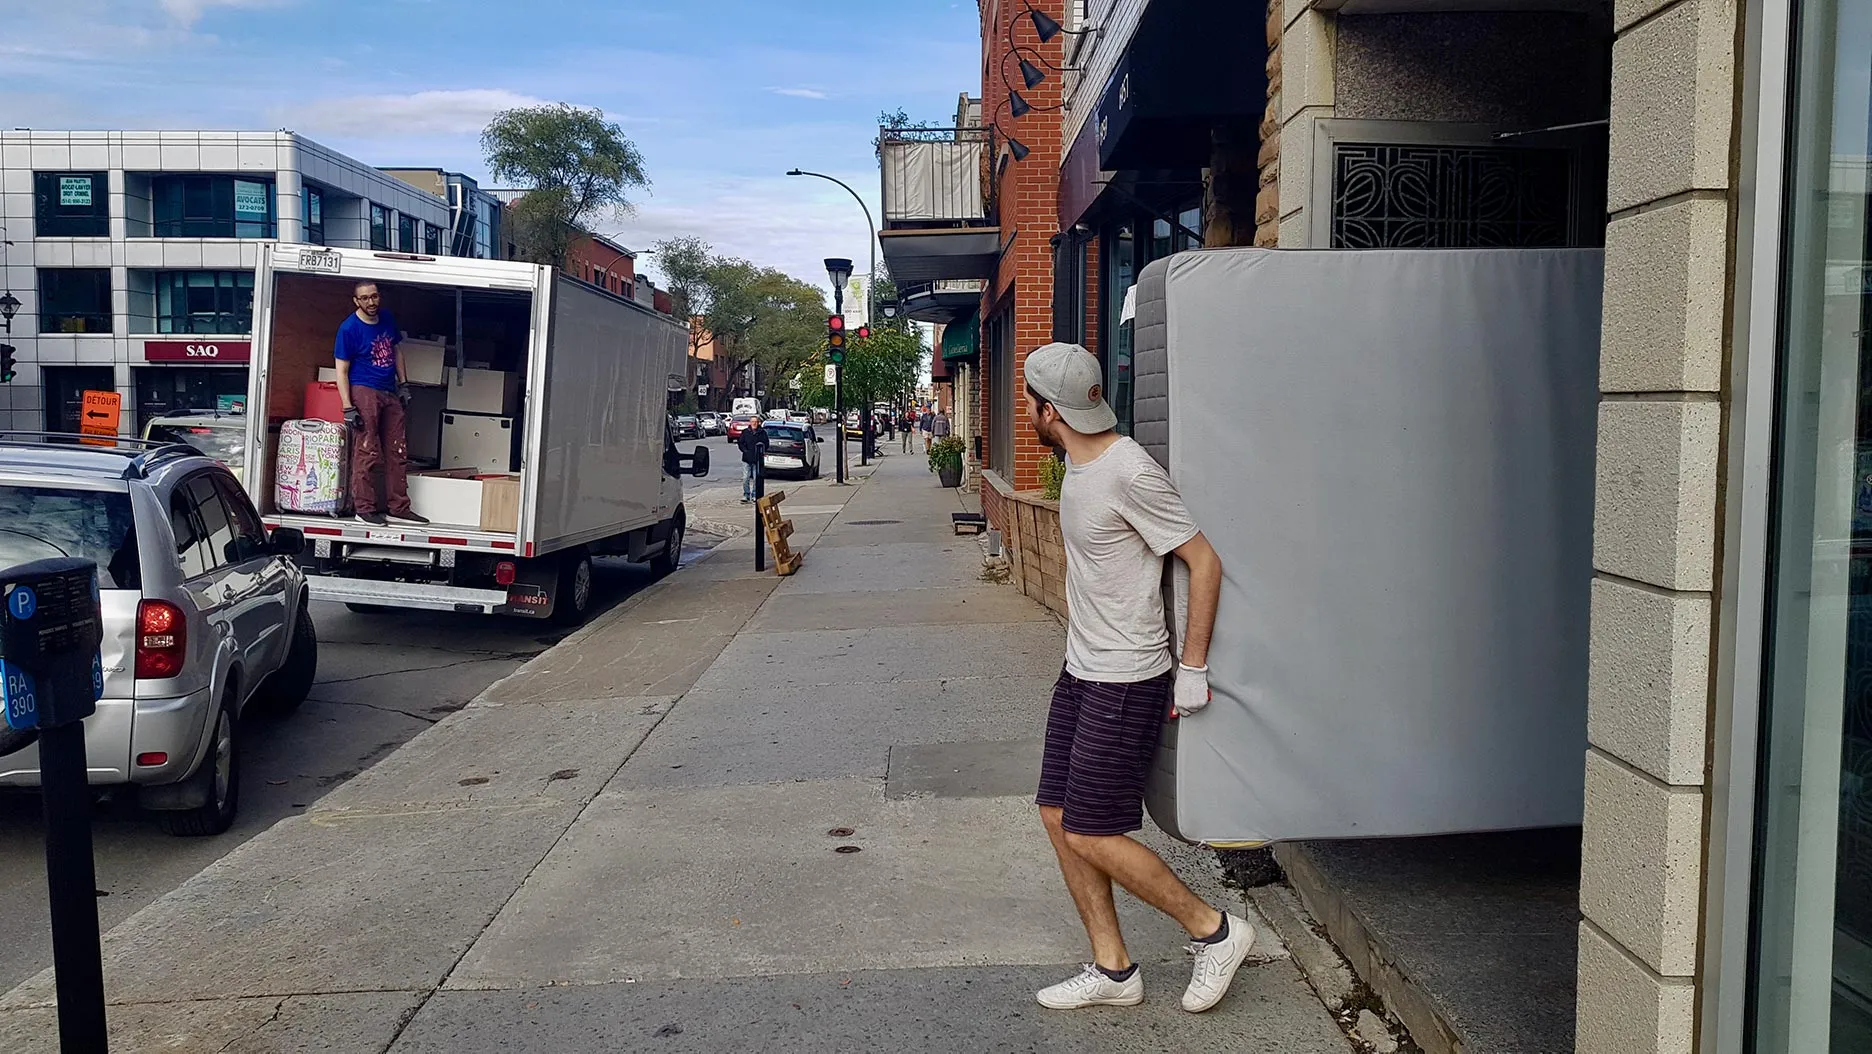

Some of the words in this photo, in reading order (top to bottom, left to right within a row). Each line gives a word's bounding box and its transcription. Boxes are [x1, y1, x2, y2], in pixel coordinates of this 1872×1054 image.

[236, 195, 266, 205] AVOCATS
[300, 254, 338, 268] FRB7131
[186, 345, 219, 357] SAQ
[86, 395, 118, 406] DÉTOUR
[509, 595, 549, 605] TRANSIT
[9, 673, 28, 696] RA
[12, 693, 35, 718] 390
